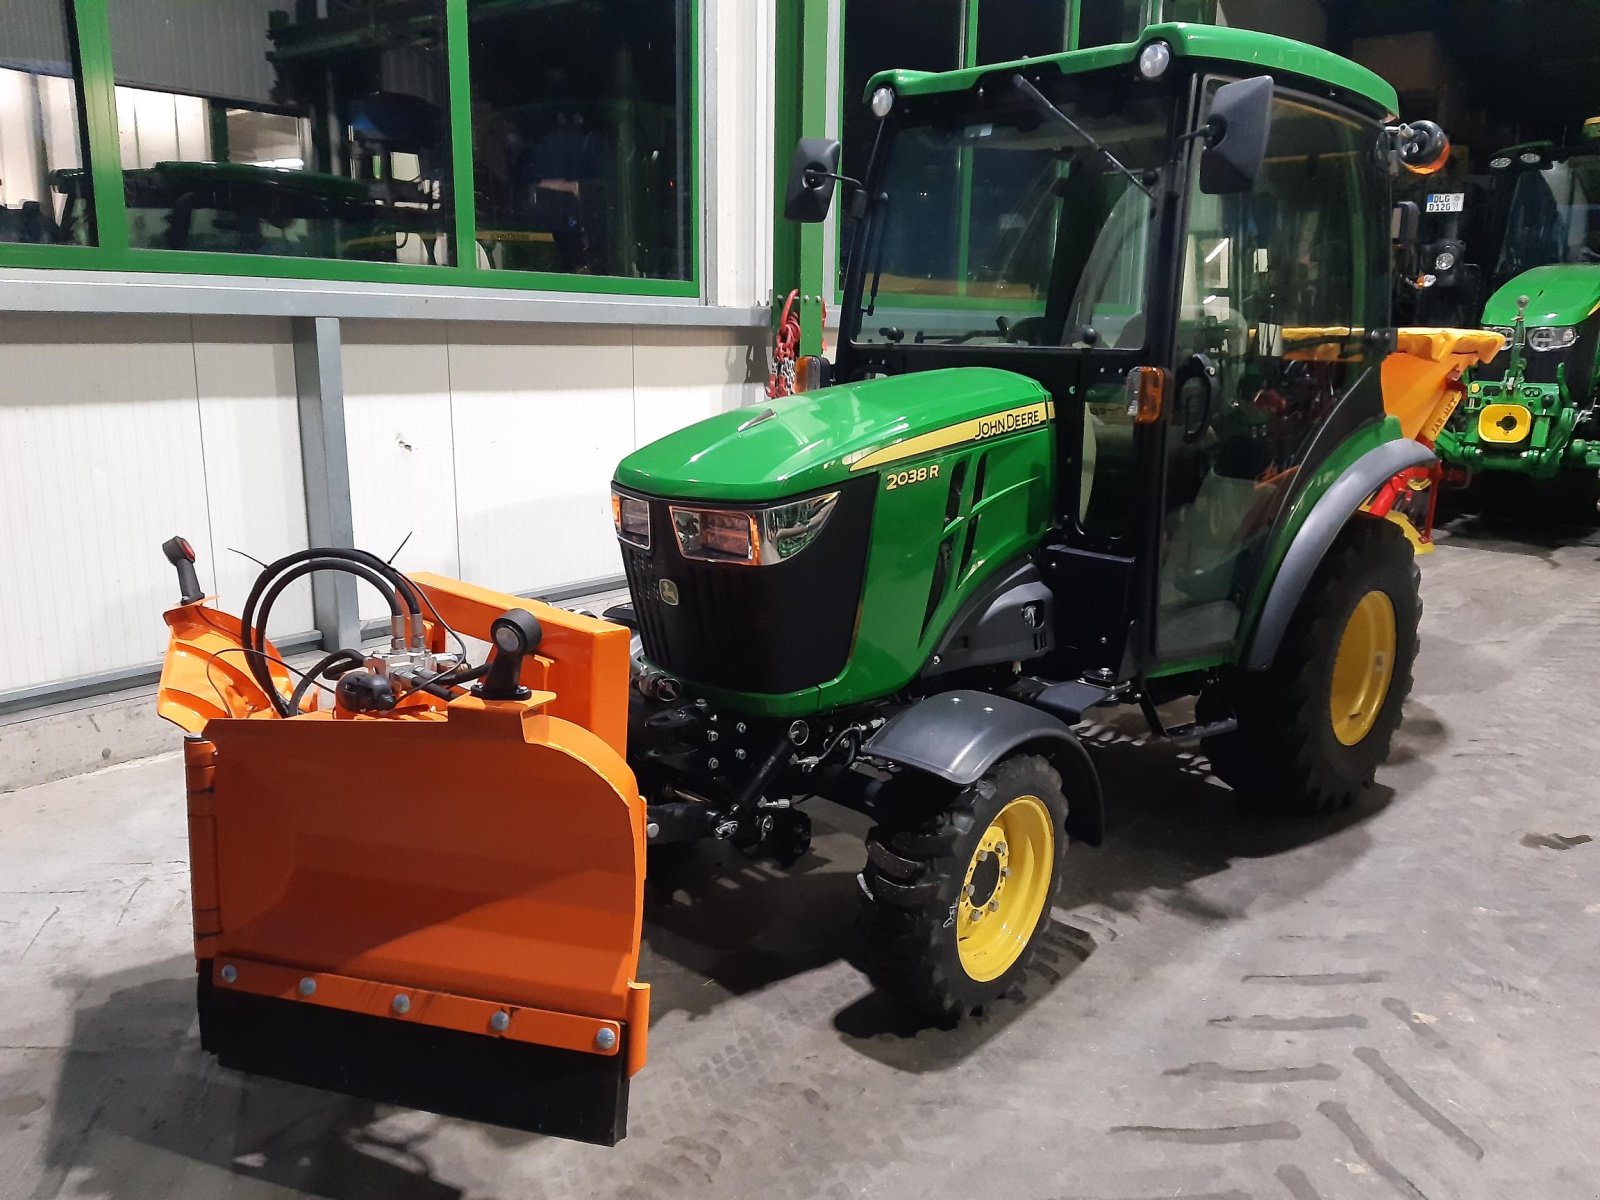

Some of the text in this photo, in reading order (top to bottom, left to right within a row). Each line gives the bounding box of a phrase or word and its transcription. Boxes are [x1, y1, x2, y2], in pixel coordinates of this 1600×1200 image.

[1434, 195, 1450, 203] DLG
[975, 410, 1039, 439] JOHN DEERE
[886, 464, 940, 490] 2038 R
